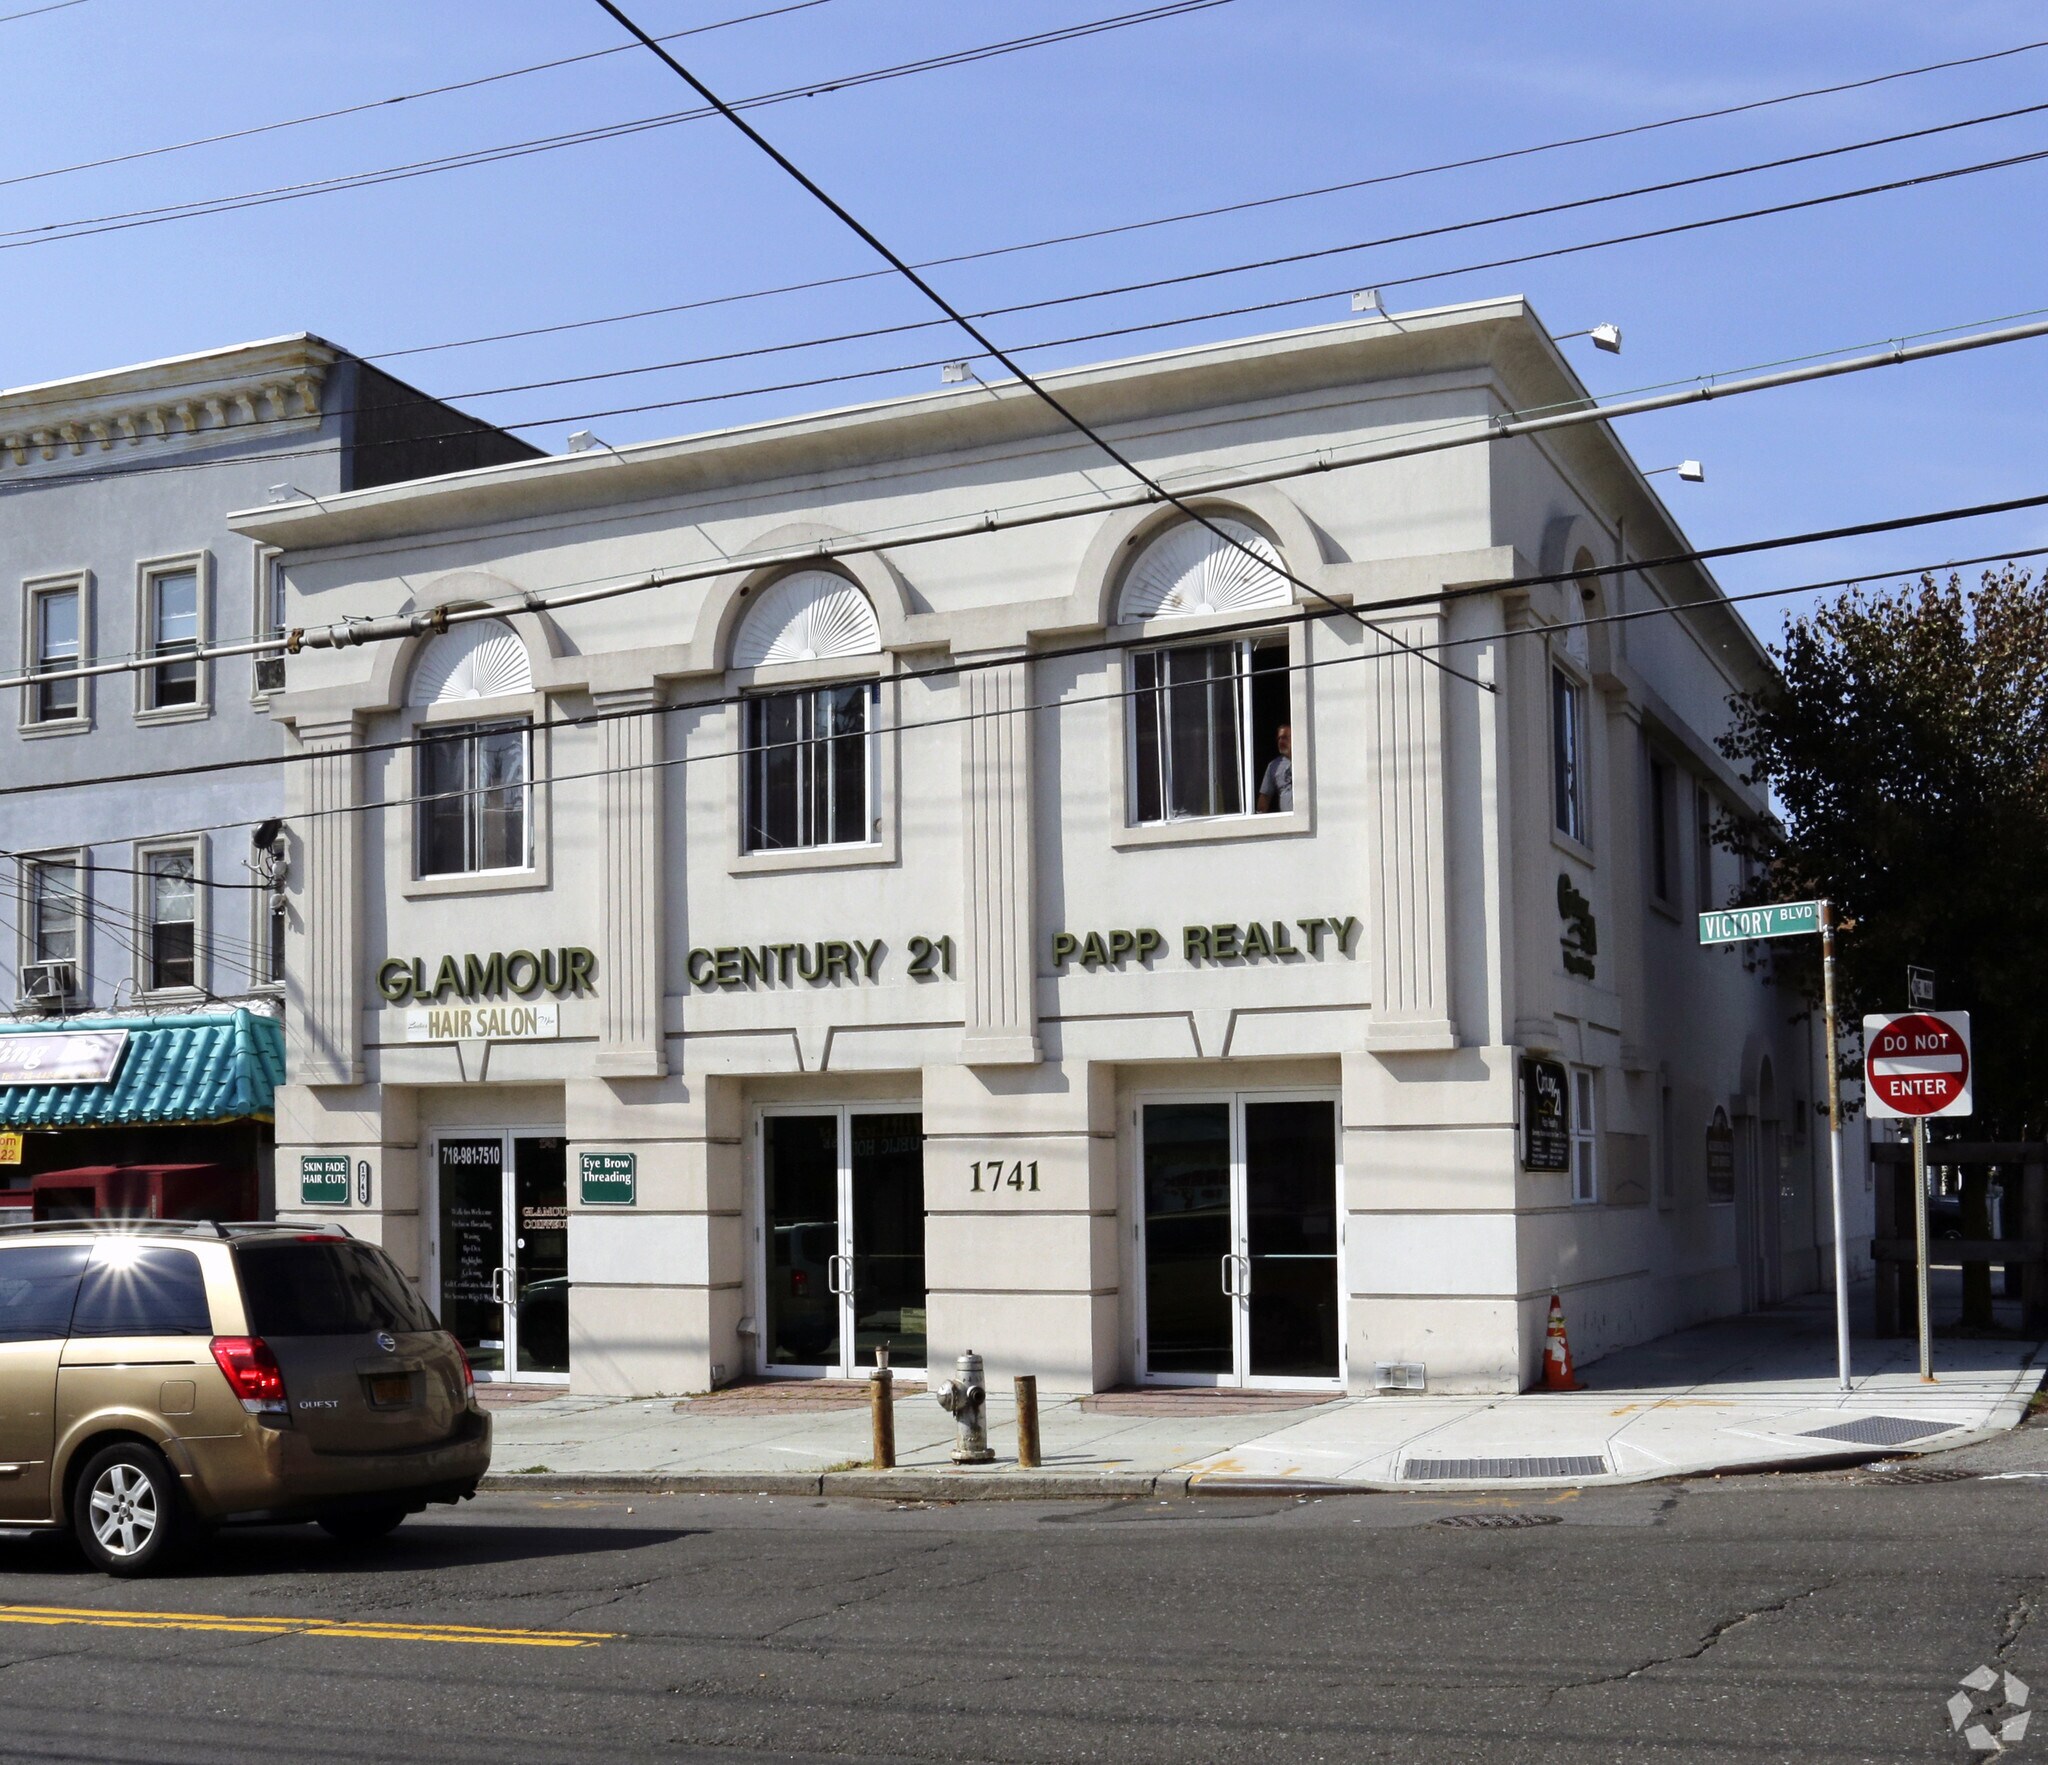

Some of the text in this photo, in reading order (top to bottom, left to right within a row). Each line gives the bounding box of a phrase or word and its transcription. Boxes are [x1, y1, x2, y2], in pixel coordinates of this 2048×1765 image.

[1705, 906, 1812, 939] VICTORY BLVD
[1052, 916, 1356, 967] PAPP REALTY
[686, 934, 951, 985] CENTURY 21
[377, 946, 598, 1001] GLAMOUR
[428, 1009, 472, 1039] HAIR
[476, 1007, 538, 1037] SALON
[1884, 1033, 1949, 1052] DO NOT
[1890, 1079, 1947, 1097] ENTER
[442, 1146, 500, 1165] 718-981-7510
[583, 1157, 630, 1170] Eye Brow
[304, 1162, 345, 1172] SKIN FADE
[969, 1160, 1041, 1193] 1741
[303, 1173, 346, 1184] HAIR CUTS
[583, 1171, 632, 1186] Threading
[523, 1219, 568, 1230] COIFFEU
[300, 1400, 339, 1410] QUEST
